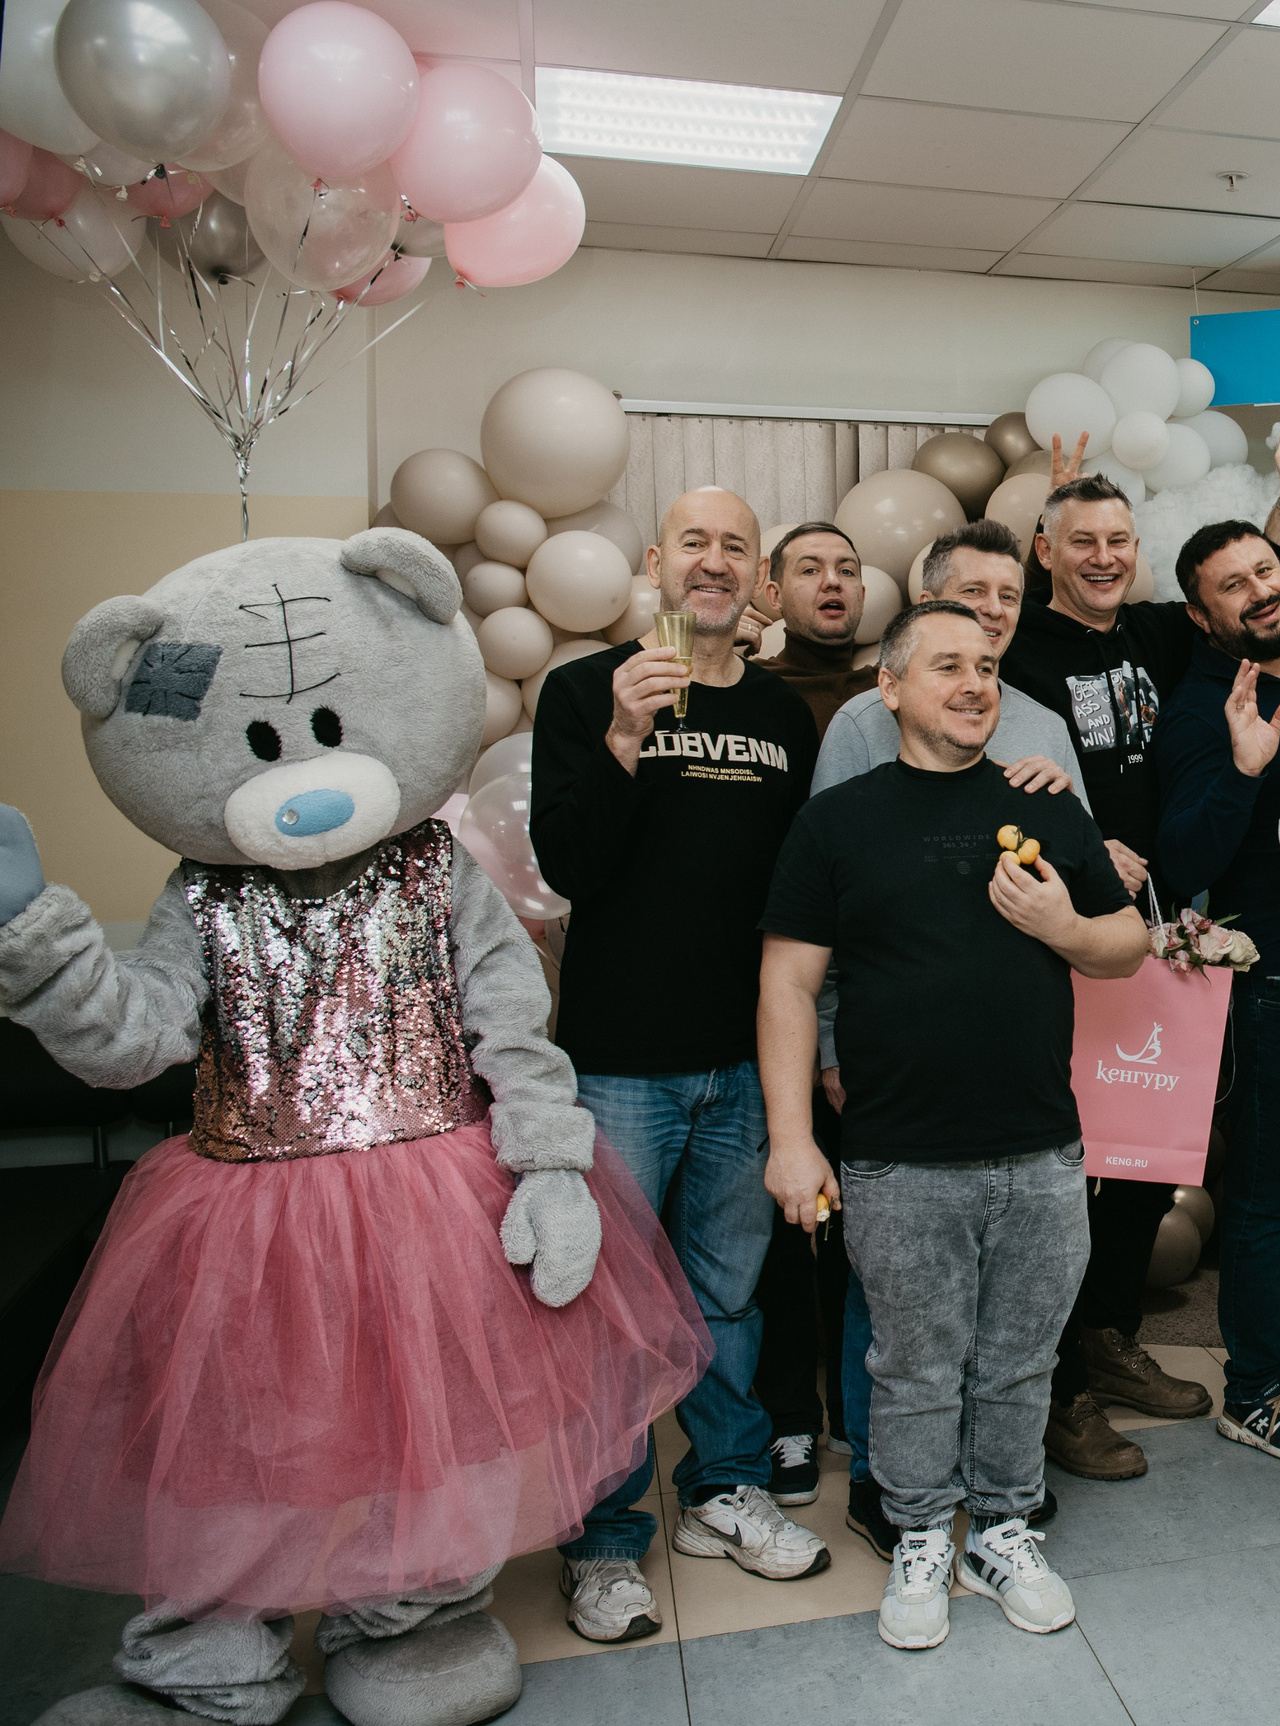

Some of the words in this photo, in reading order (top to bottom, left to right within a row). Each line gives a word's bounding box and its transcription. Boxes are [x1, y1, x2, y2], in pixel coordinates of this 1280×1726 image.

[1074, 681, 1099, 702] GET
[1075, 700, 1101, 718] ASS
[1088, 714, 1111, 729] AND
[1081, 727, 1115, 748] WIN!
[922, 834, 991, 842] WORLDWIDE
[1105, 1156, 1149, 1168] KENG.RU
